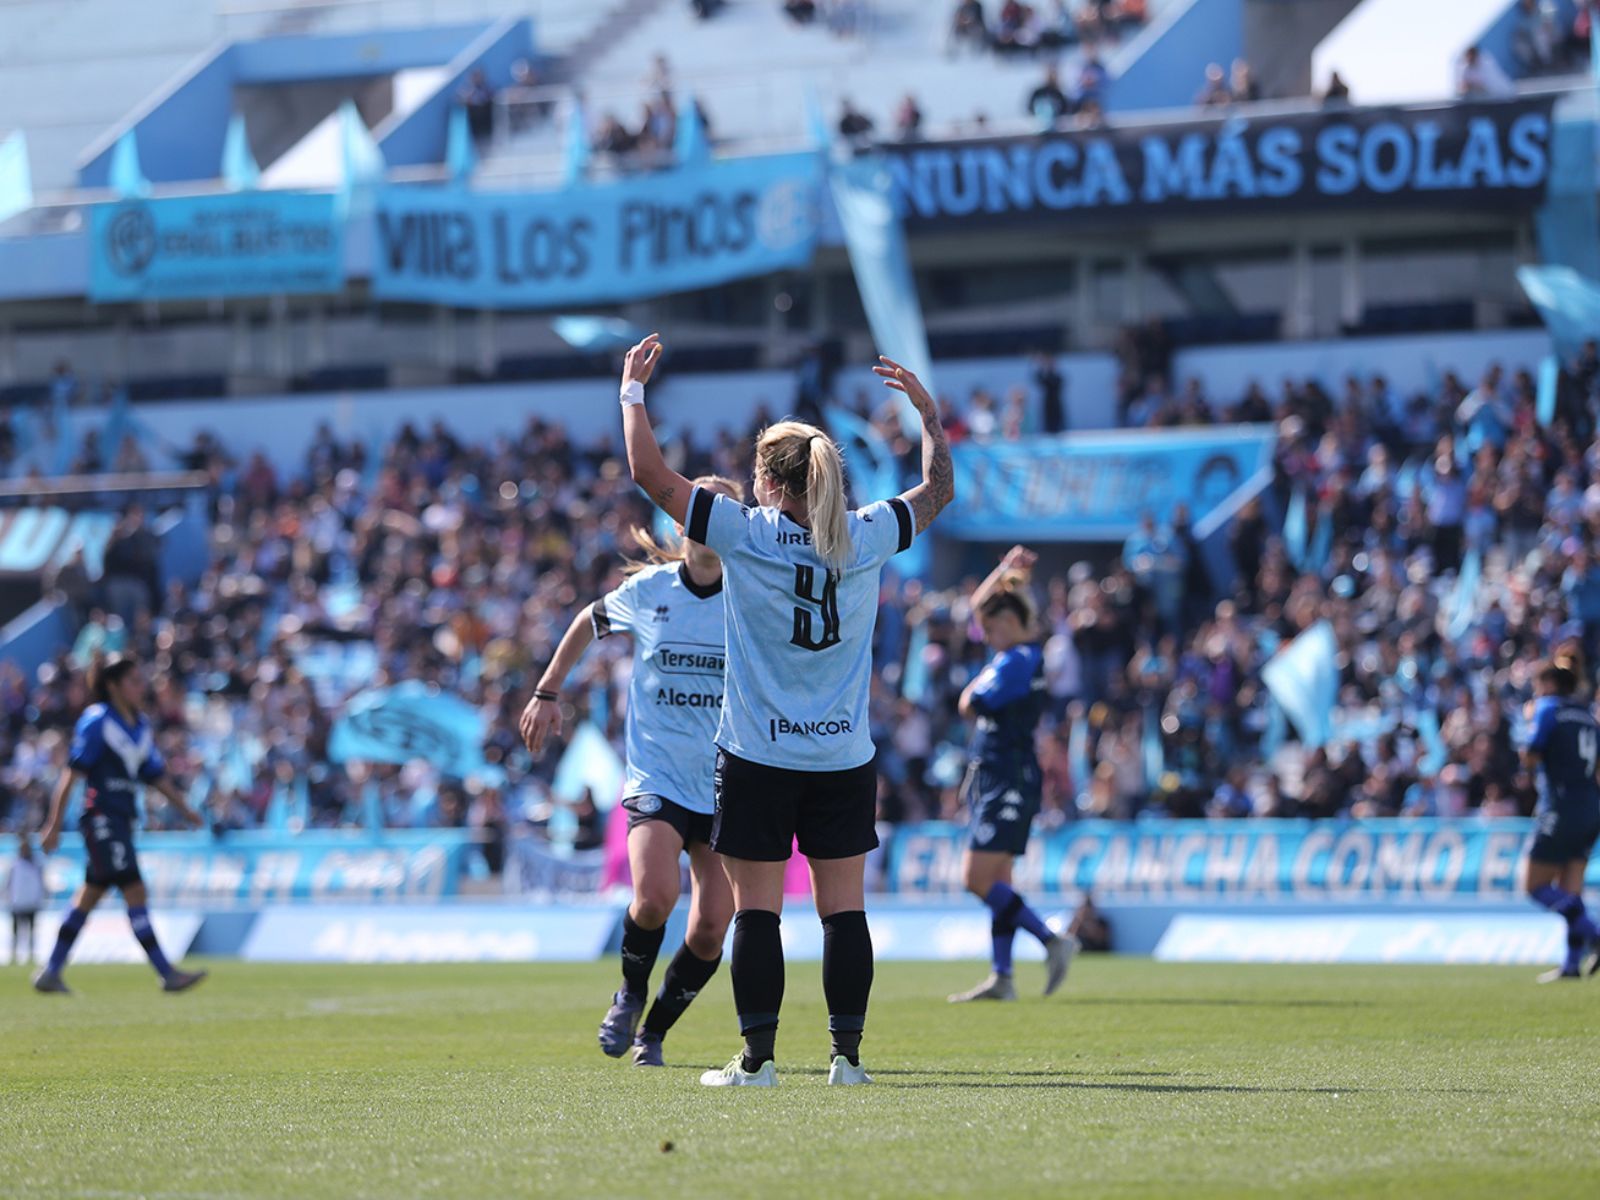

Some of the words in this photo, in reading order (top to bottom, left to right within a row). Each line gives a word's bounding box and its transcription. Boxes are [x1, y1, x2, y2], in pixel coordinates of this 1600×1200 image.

[887, 138, 1132, 217] NUNCA
[1140, 112, 1304, 203] MÁS
[1314, 112, 1549, 195] SOLAS
[776, 530, 812, 546] IRE
[778, 719, 853, 736] BANCOR
[1058, 828, 1279, 902] CANCHA
[1291, 824, 1465, 901] COMO
